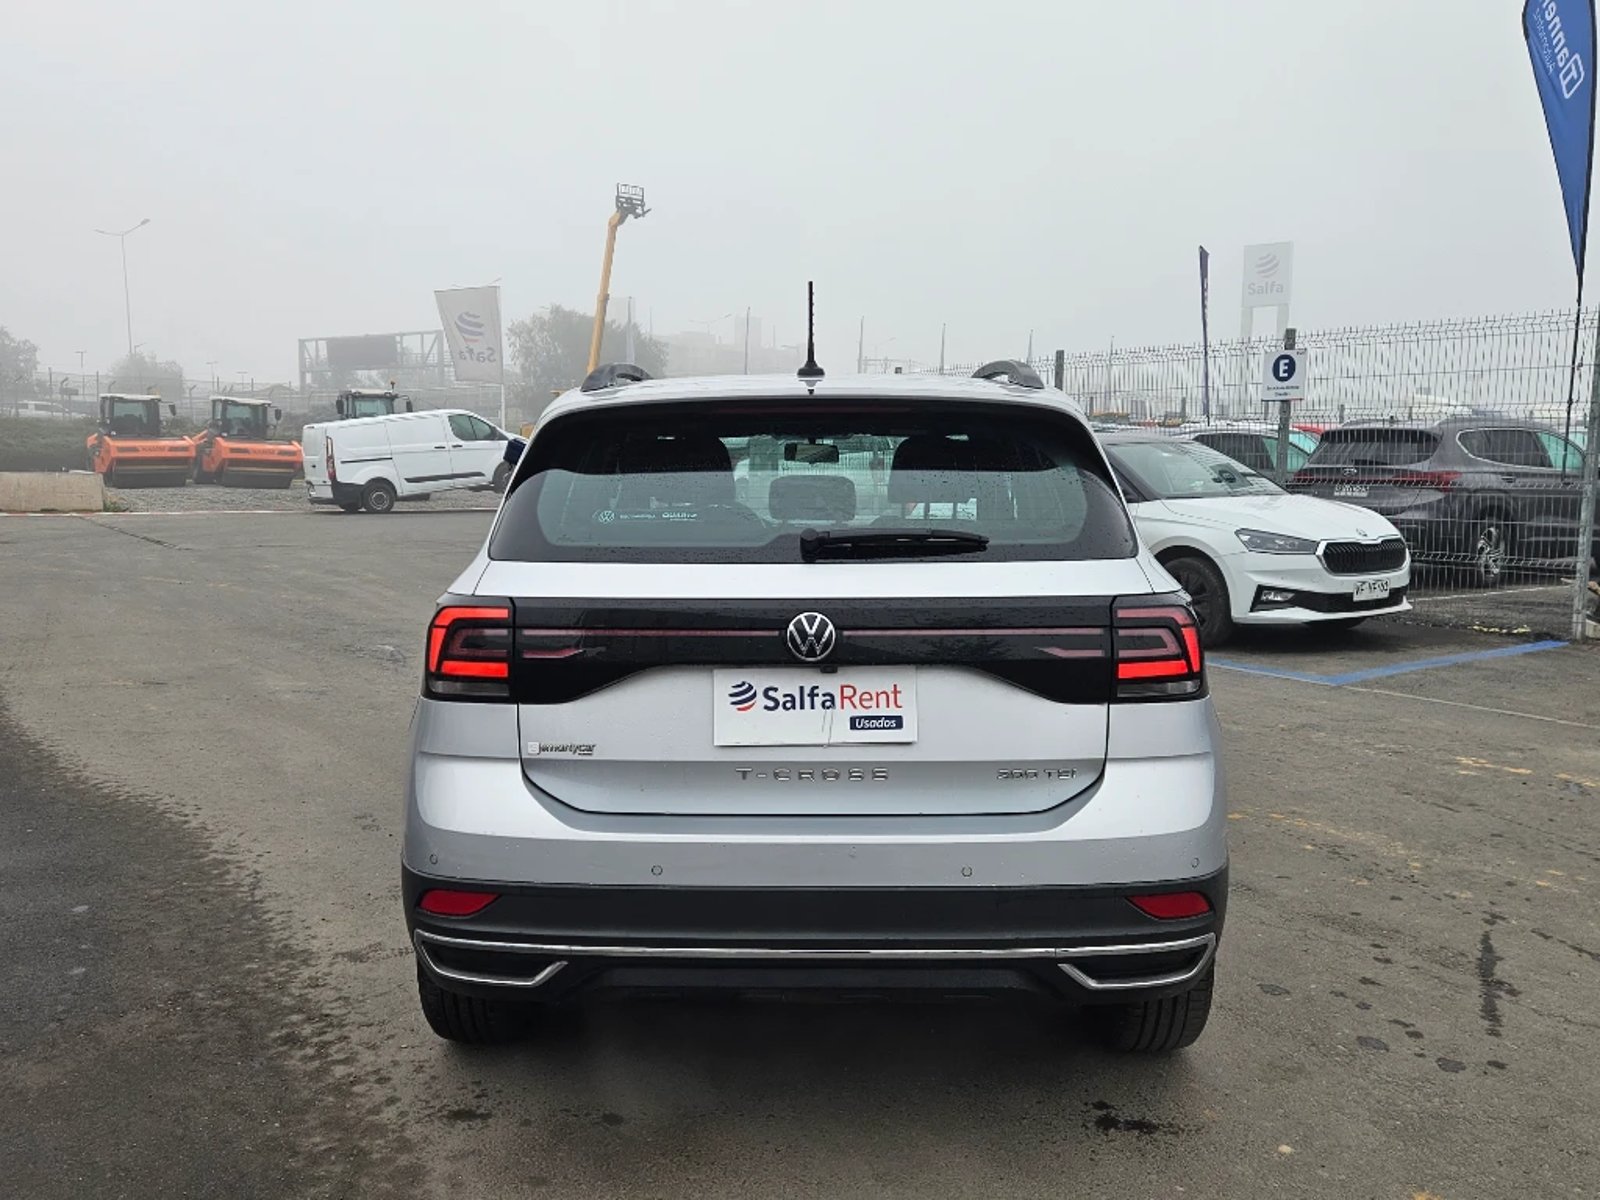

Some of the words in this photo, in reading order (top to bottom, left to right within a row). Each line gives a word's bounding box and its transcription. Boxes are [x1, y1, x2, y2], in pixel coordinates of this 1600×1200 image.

[1247, 281, 1284, 295] Salfa
[1279, 359, 1290, 377] E
[762, 684, 903, 711] SalfaRent
[855, 717, 897, 729] Usados
[735, 767, 889, 783] T-CROSS
[996, 768, 1038, 780] 200
